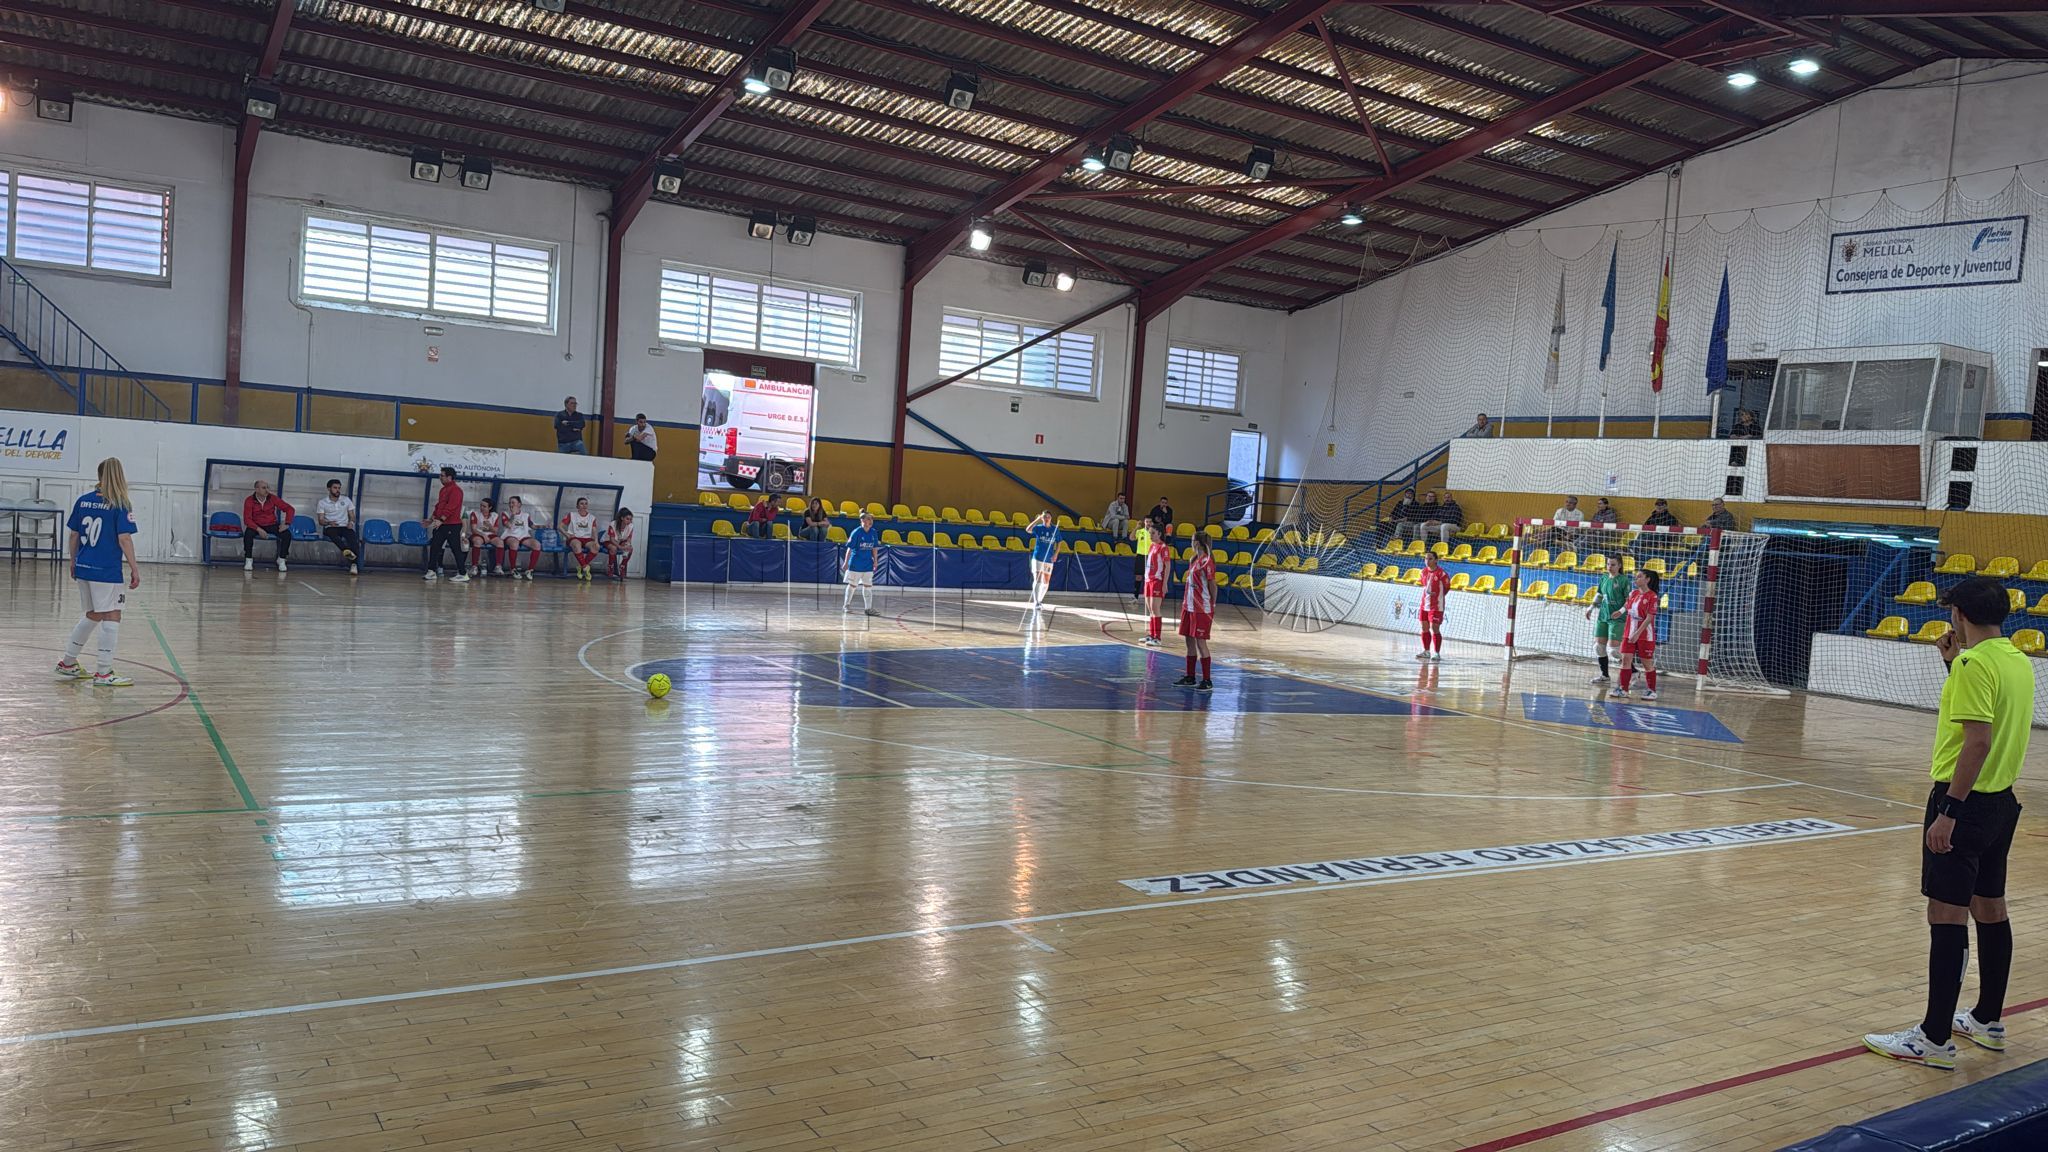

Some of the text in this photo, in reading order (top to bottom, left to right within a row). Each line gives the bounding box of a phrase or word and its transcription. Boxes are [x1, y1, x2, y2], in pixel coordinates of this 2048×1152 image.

[1863, 245, 1914, 257] MELILLA
[1836, 256, 2012, 284] Consejería de Deporte y Juventud
[759, 383, 810, 395] AMBULANCIA
[5, 449, 21, 457] DEL
[80, 516, 103, 547] 30
[1147, 819, 1834, 892] PABELLÓN LÁZARO FERNÁNDEZ
